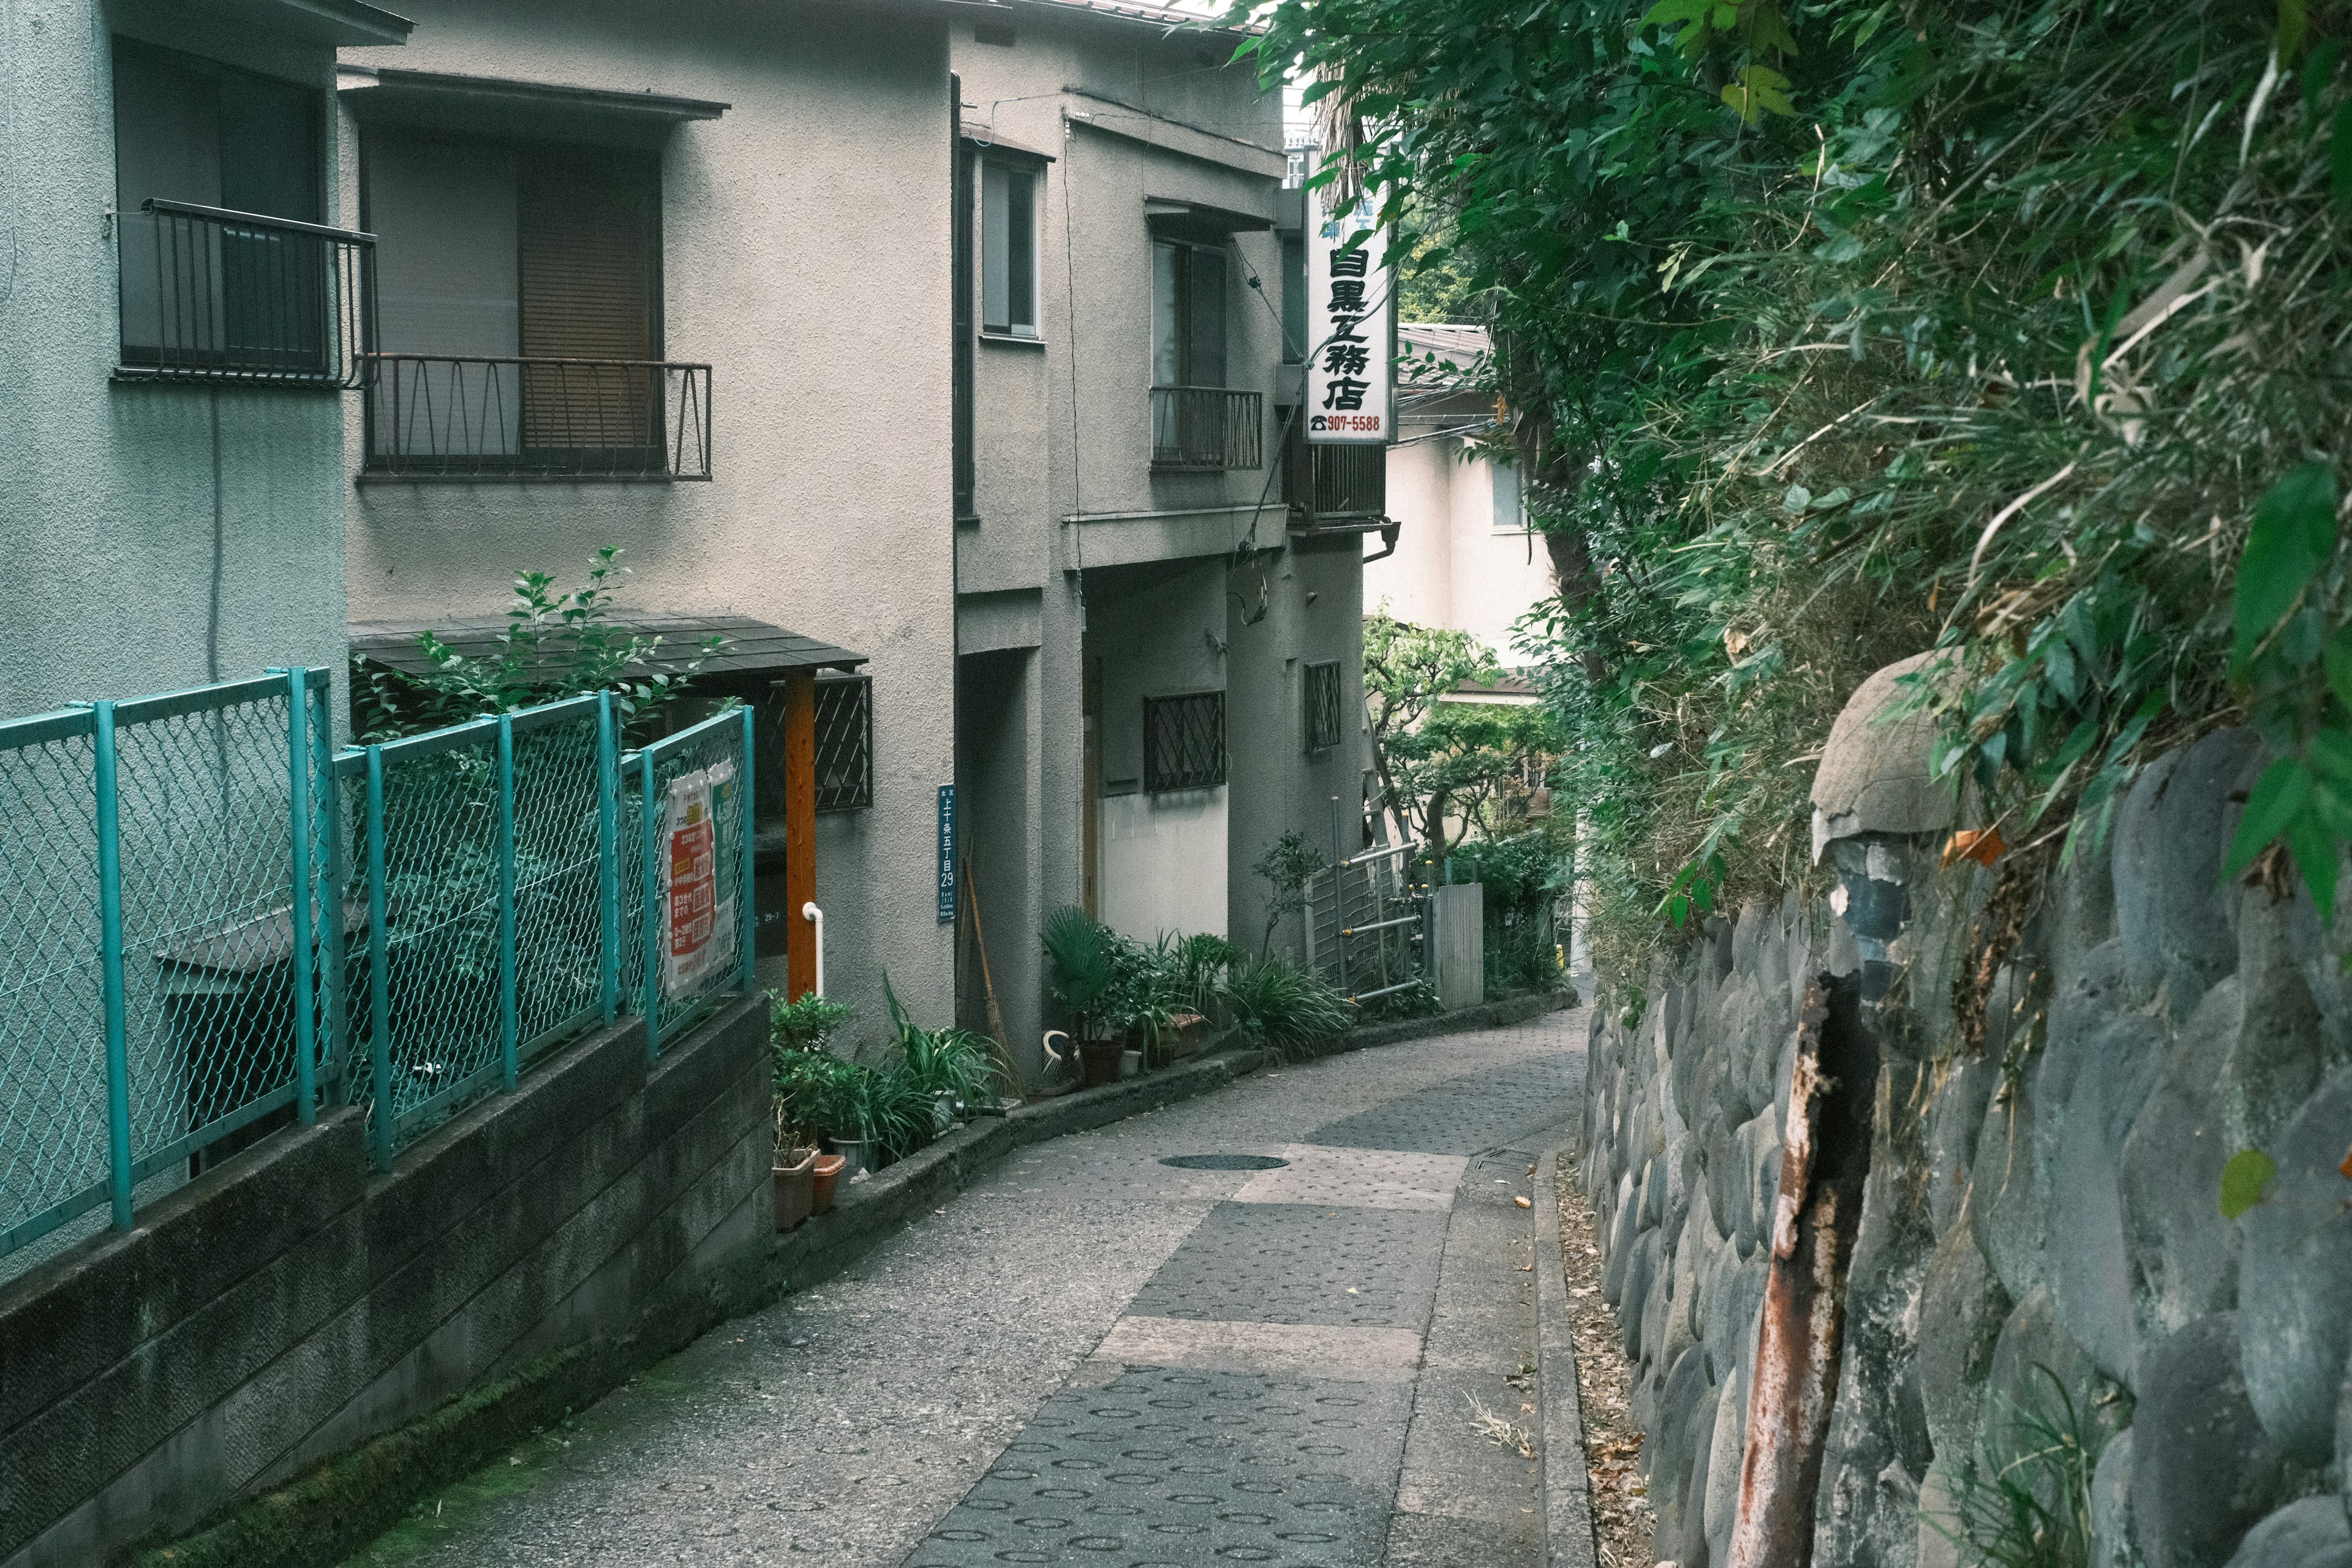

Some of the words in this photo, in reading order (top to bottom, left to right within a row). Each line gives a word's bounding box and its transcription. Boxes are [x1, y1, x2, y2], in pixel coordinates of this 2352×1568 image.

[1322, 249, 1371, 411] 目黒工務店
[1327, 415, 1380, 431] 907-5588
[941, 872, 953, 887] 29
[765, 912, 778, 921] 29-7
